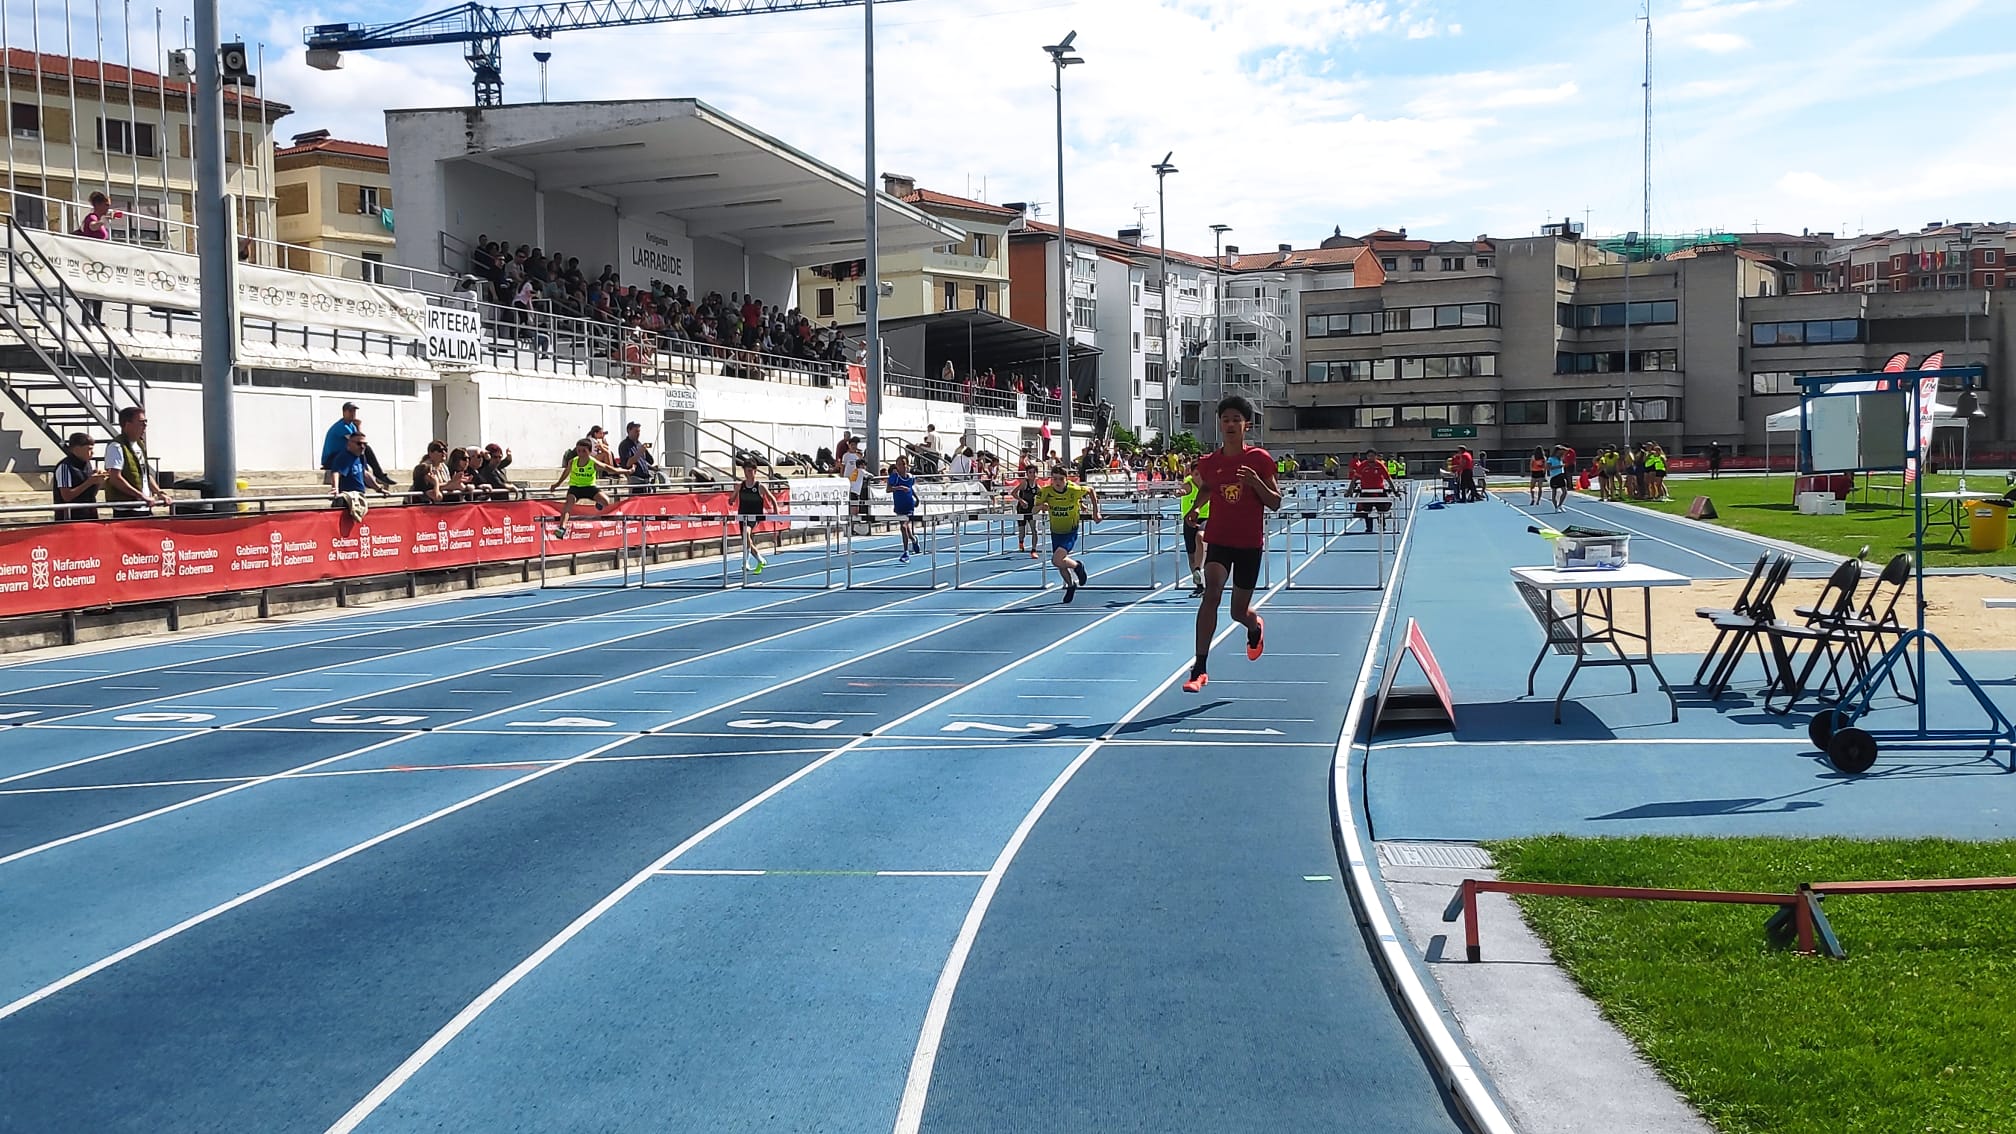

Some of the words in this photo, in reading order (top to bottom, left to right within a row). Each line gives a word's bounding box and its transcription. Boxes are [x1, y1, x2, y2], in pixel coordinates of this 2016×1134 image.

[632, 245, 682, 276] LARRABIDE
[428, 309, 478, 335] IRTEERA
[429, 335, 478, 362] SALIDA
[284, 540, 318, 552] Nafarroako
[332, 537, 359, 548] Gobierno
[178, 548, 218, 561] Nafarroako
[236, 545, 269, 556] Gobierno
[328, 551, 336, 561] de
[336, 550, 359, 561] Navarra
[53, 557, 101, 572] Nafarroako
[122, 552, 159, 566] Gobierno
[231, 560, 240, 571] de
[241, 559, 269, 570] Navarra
[283, 555, 314, 566] Gobernua
[115, 570, 127, 582] de
[127, 569, 159, 581] Navarra
[178, 564, 214, 576] Gobernua
[53, 574, 96, 588] Gobernua
[310, 715, 430, 725] 5
[505, 717, 617, 727] 4
[726, 719, 844, 730] 3
[940, 721, 1058, 733] 2
[1171, 727, 1287, 735] 1
